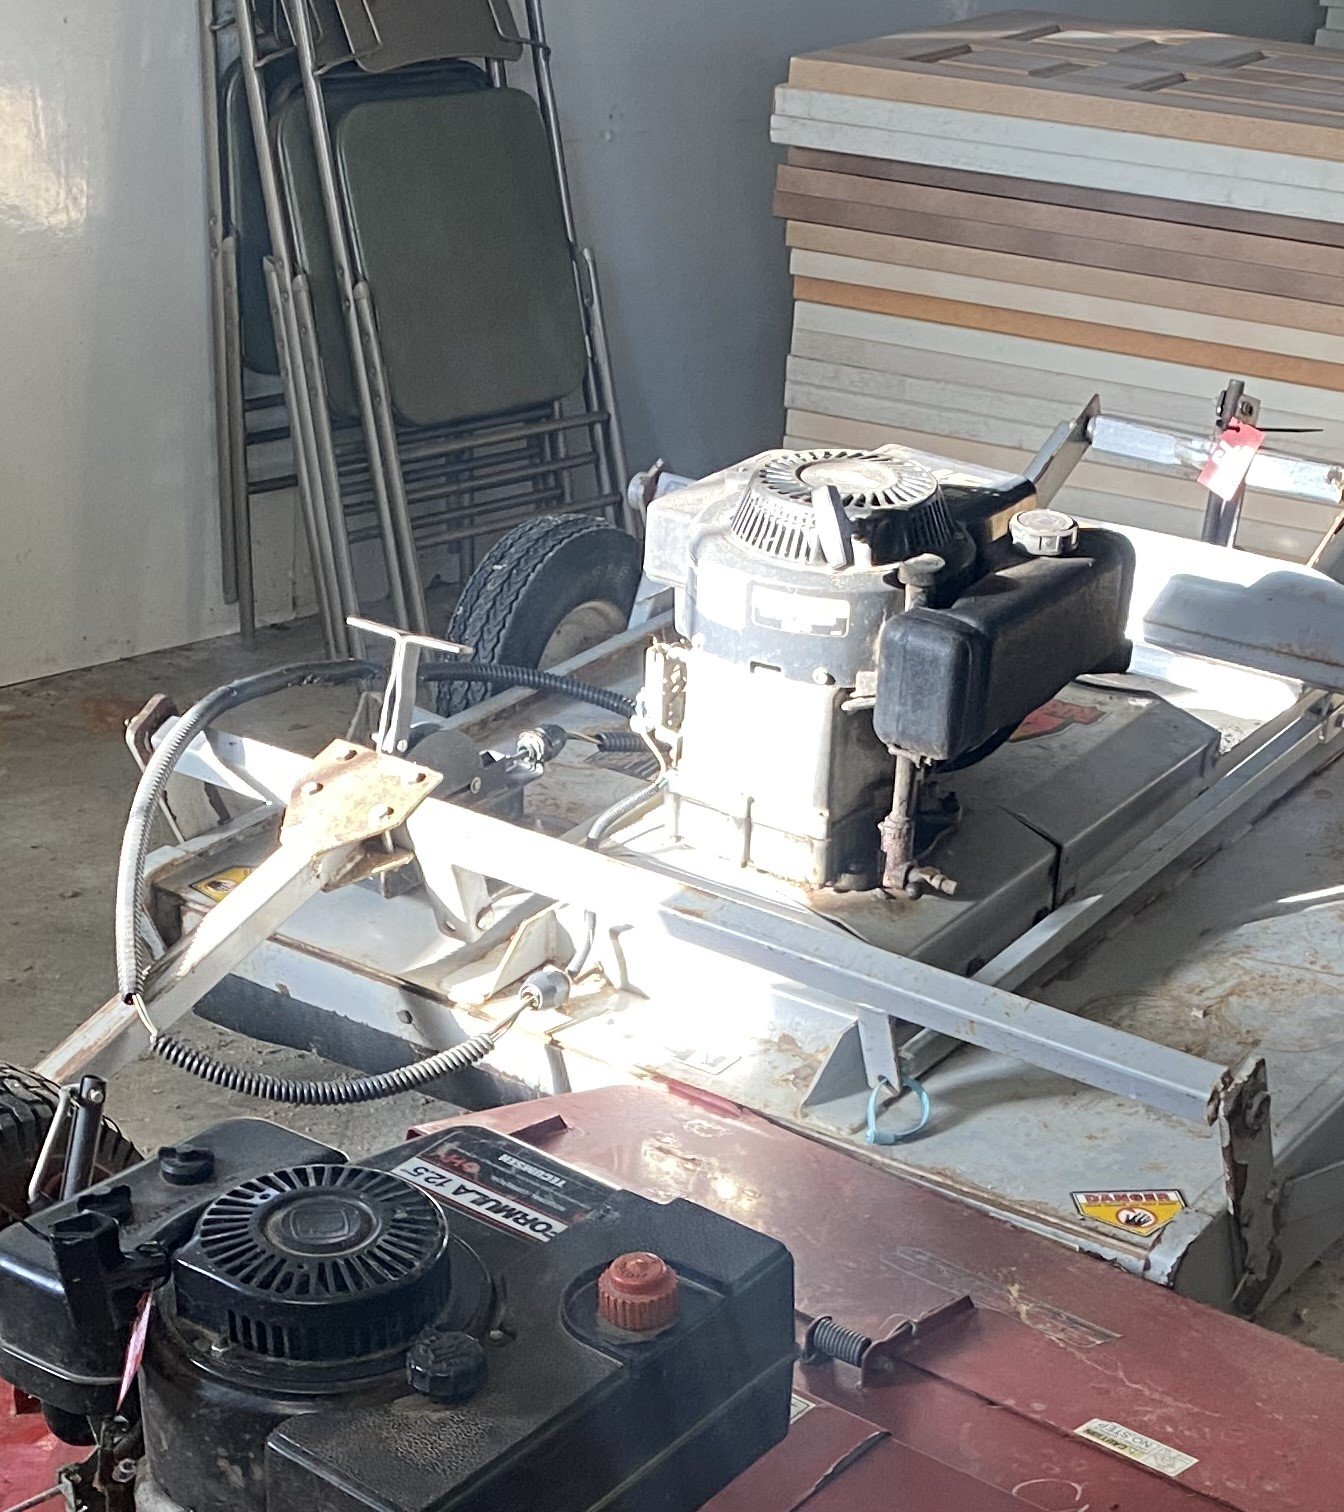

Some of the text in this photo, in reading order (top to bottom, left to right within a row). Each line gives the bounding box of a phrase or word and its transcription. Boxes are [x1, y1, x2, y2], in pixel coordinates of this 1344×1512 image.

[408, 1166, 453, 1187] 12.5
[498, 1153, 566, 1188] TECUMSEH
[1097, 1423, 1132, 1438] STEP
[1132, 1436, 1154, 1448] NO
